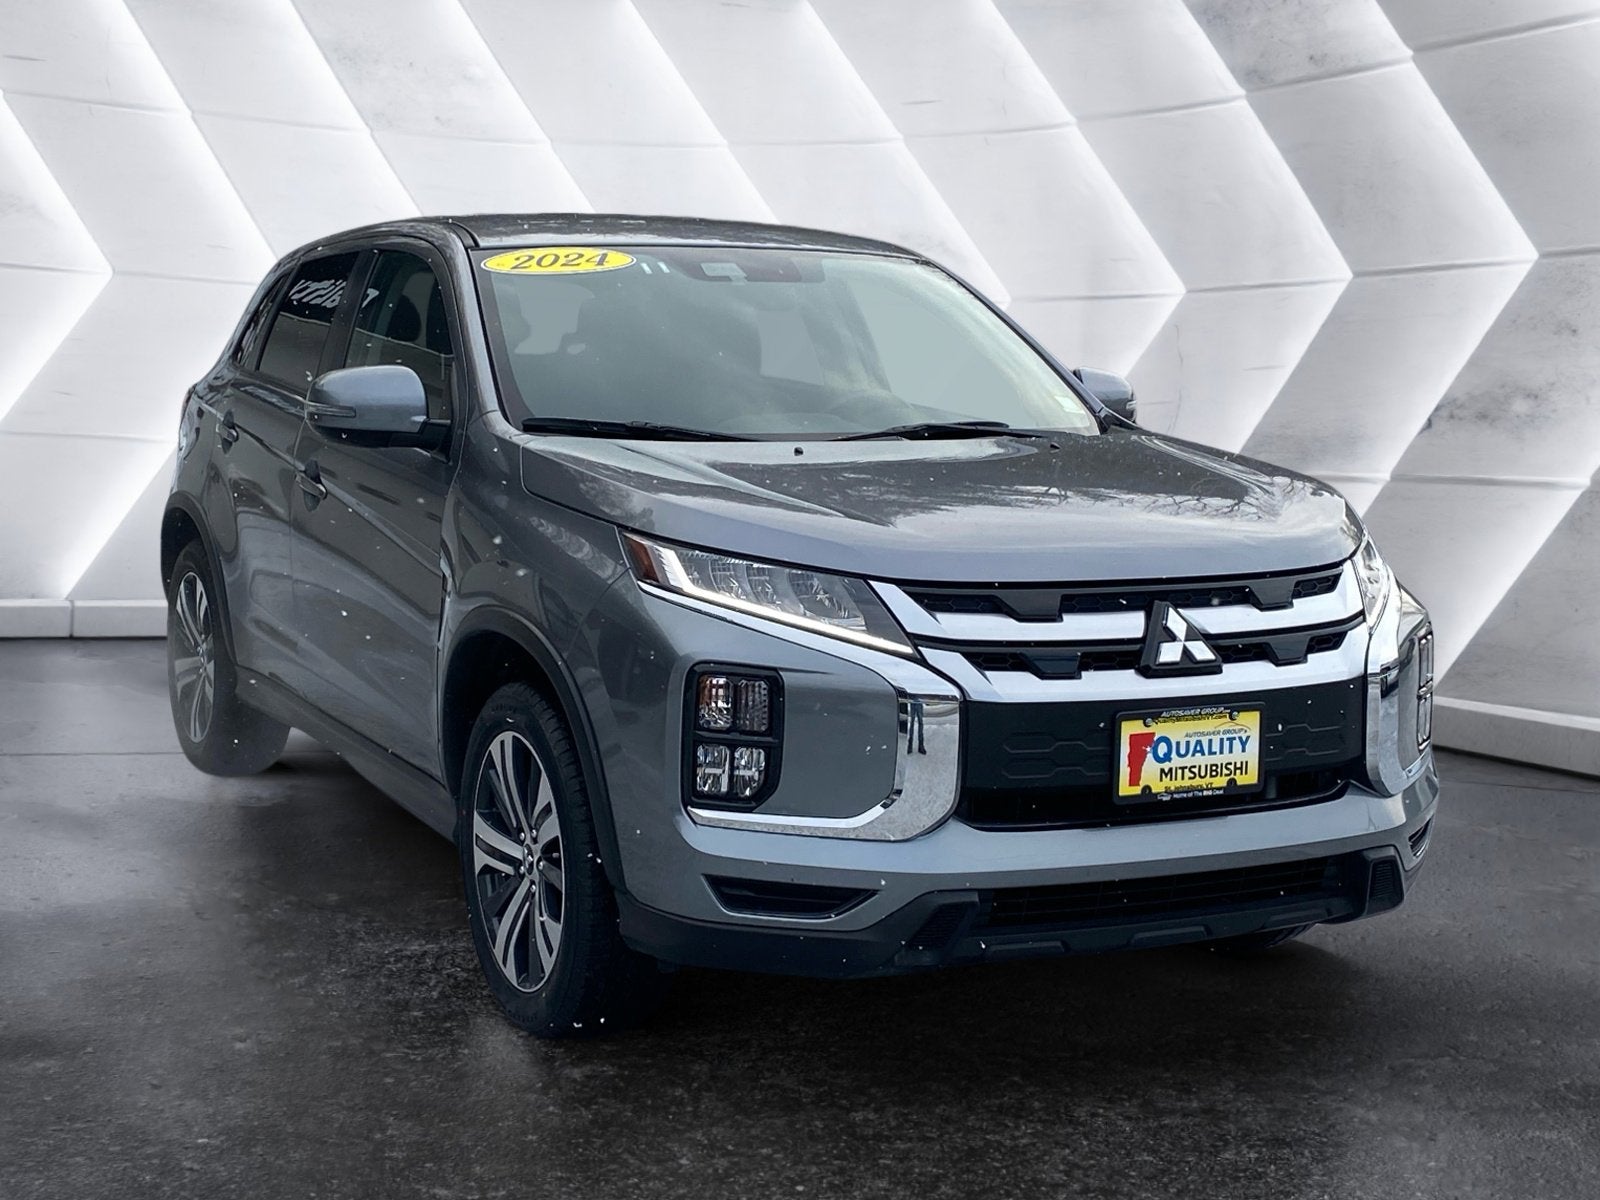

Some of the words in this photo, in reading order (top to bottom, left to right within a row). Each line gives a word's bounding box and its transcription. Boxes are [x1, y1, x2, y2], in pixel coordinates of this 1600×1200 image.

[509, 252, 610, 271] 2024
[1184, 729, 1221, 738] AUTOSAVER
[1152, 735, 1251, 764] QUALITY
[1159, 760, 1249, 782] MITSUBISHI
